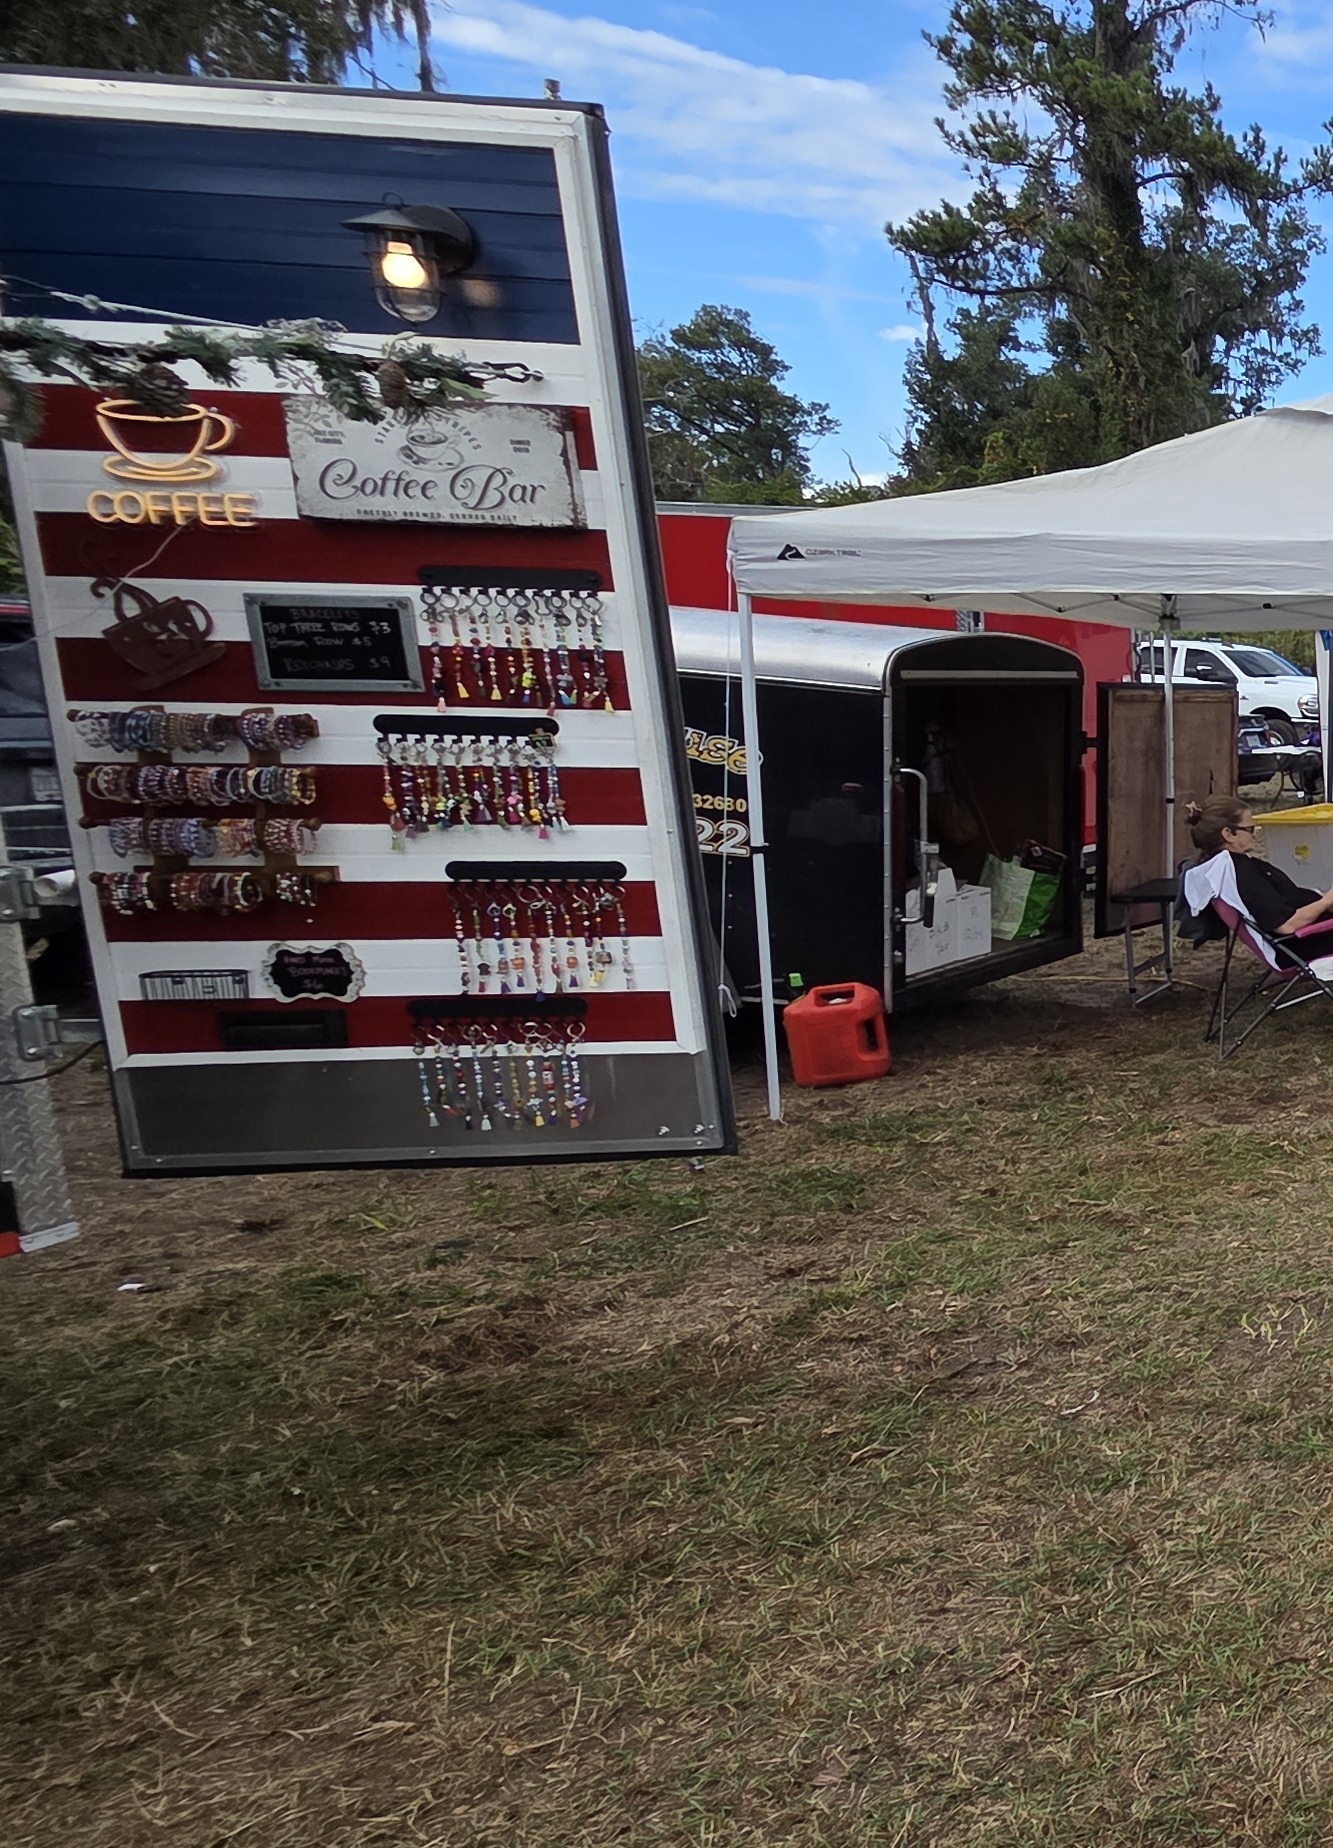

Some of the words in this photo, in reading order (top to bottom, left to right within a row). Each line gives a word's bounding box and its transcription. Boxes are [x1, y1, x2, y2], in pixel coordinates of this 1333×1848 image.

[319, 458, 438, 500] Coffee
[449, 464, 545, 511] Bar
[86, 489, 260, 529] COFFEE
